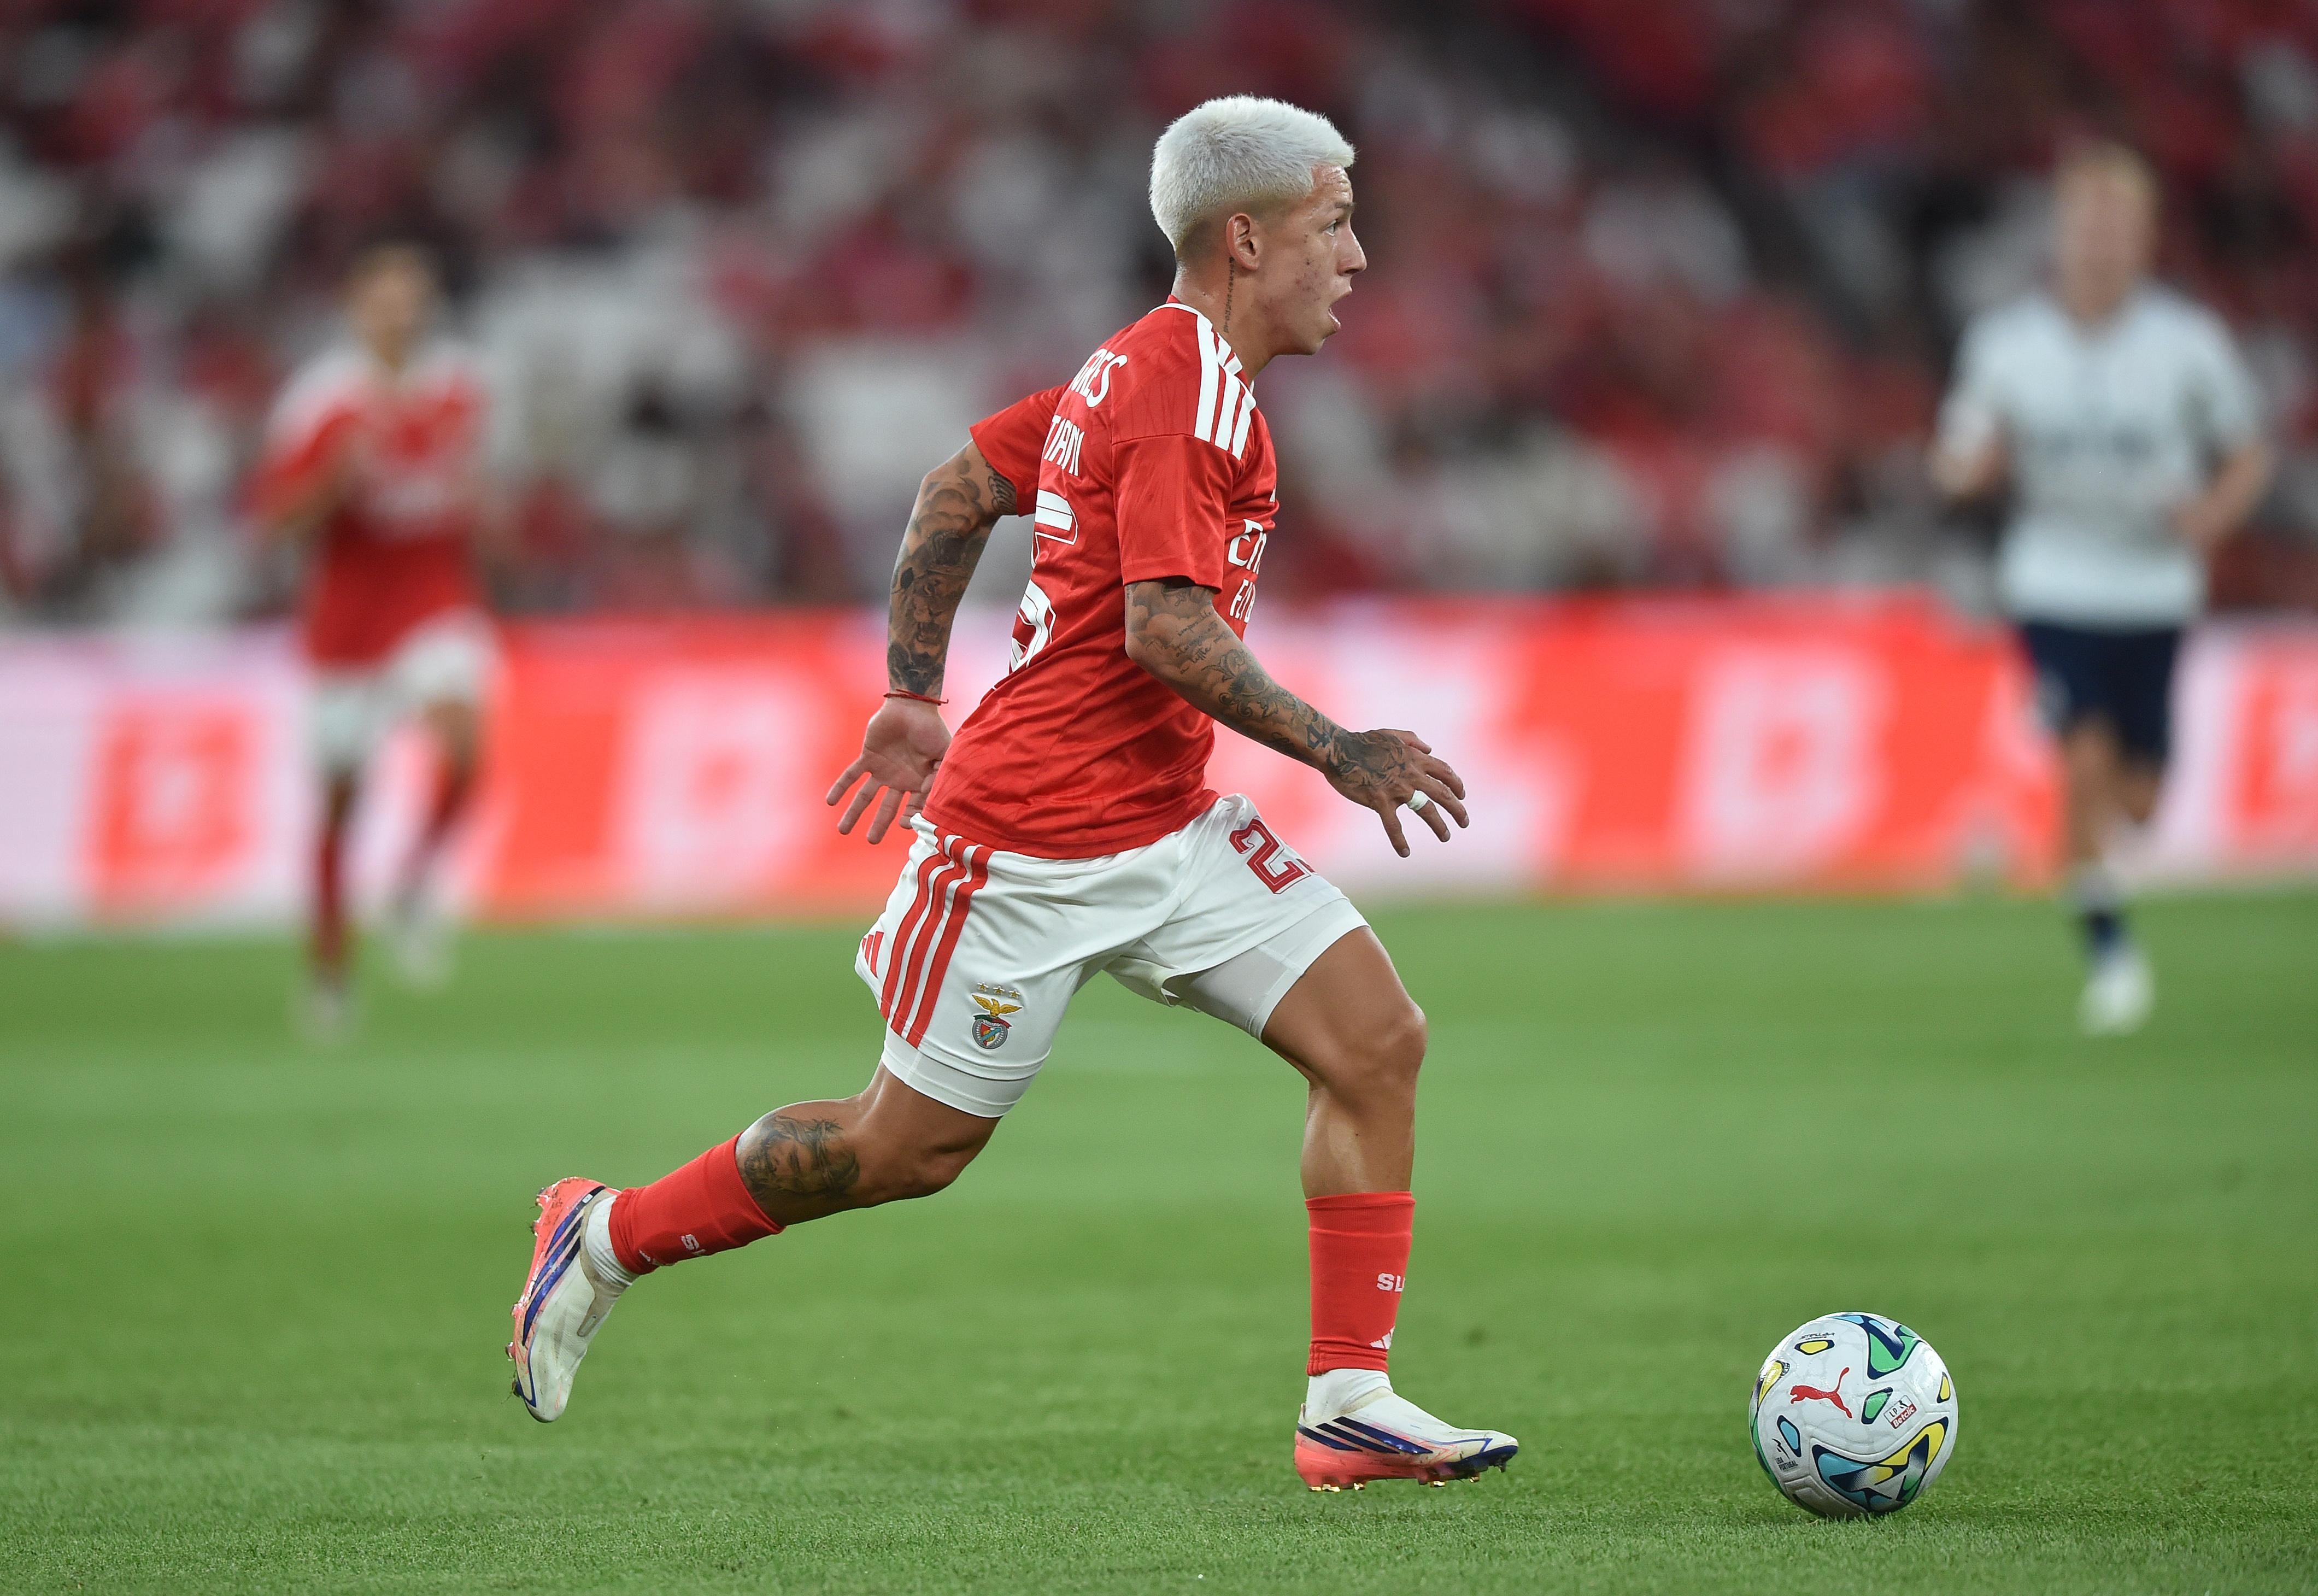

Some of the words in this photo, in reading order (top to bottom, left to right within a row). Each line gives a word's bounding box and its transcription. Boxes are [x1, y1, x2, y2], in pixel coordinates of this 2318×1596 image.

[1229, 815, 1316, 894] 2
[1377, 1272, 1405, 1292] SL
[1893, 1406, 1915, 1427] Betclic
